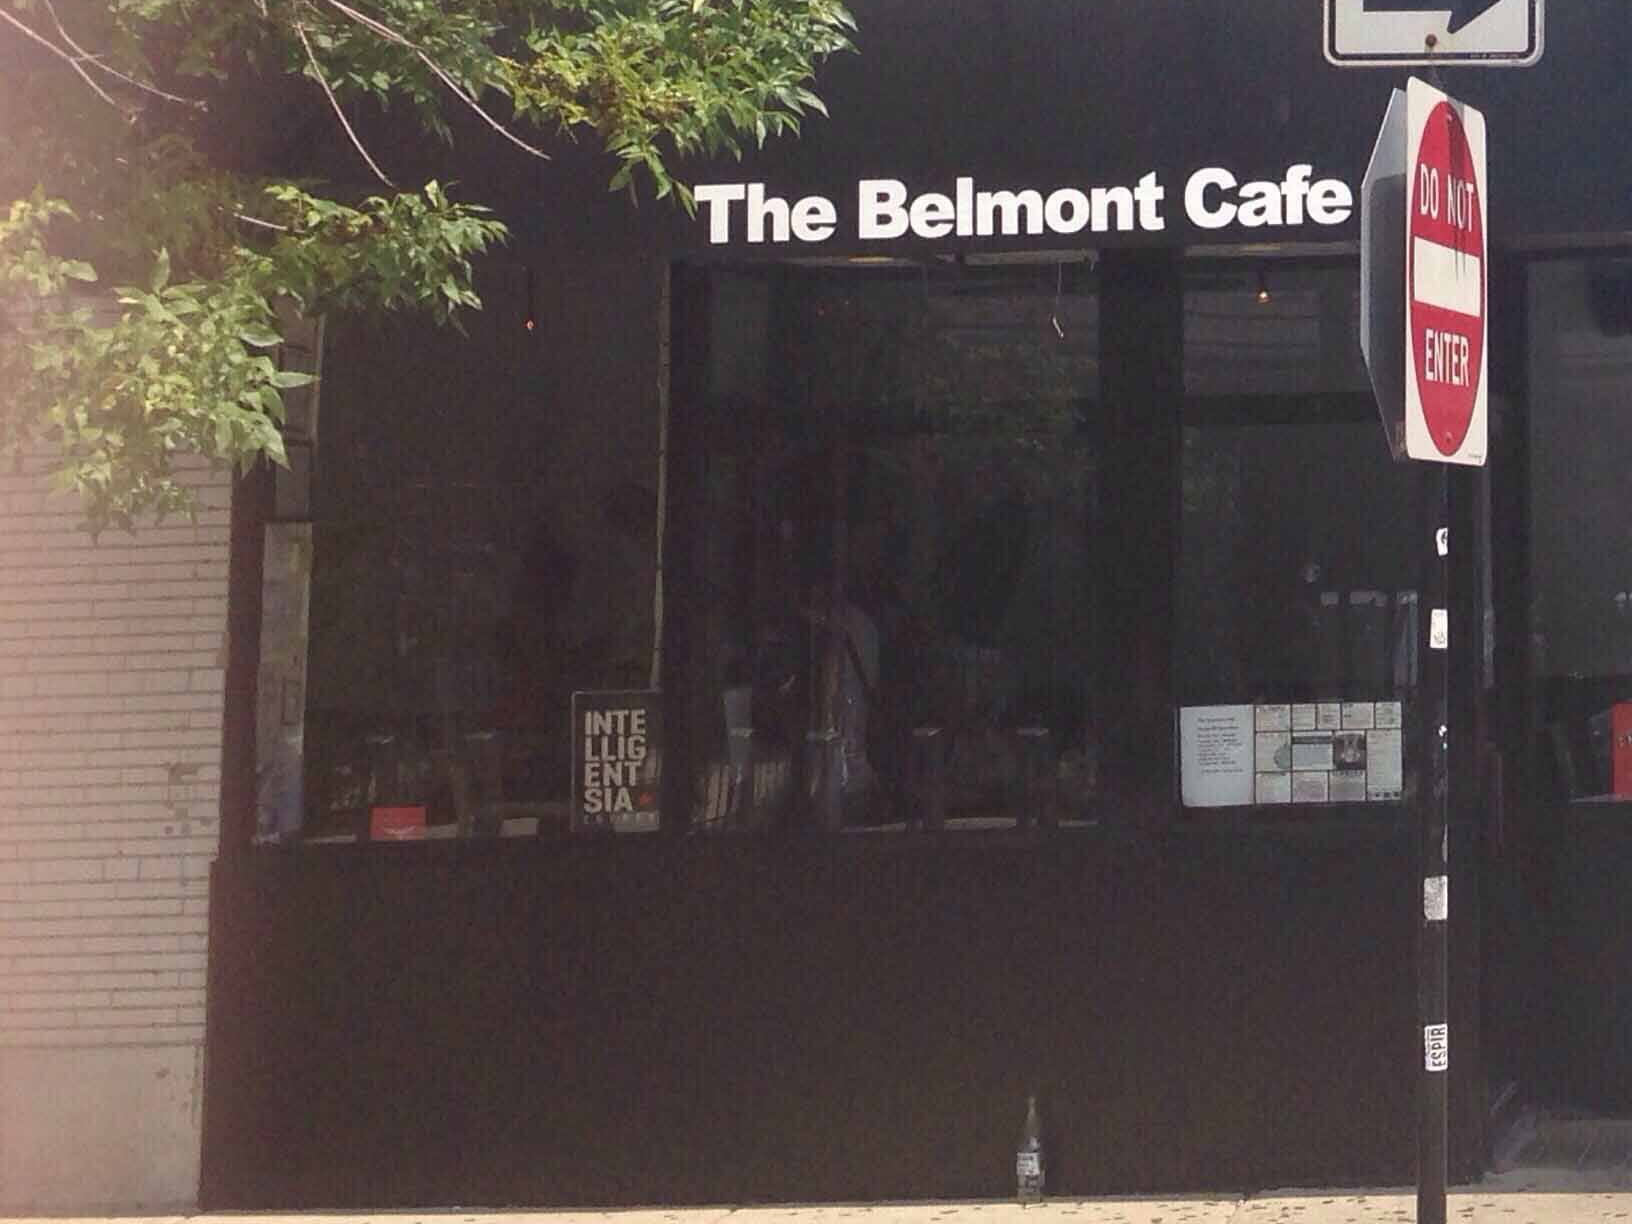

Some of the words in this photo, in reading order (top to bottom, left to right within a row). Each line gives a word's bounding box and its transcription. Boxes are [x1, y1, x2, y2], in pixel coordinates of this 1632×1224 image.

[693, 182, 838, 245] The
[857, 170, 1167, 241] Belmont
[1183, 164, 1353, 229] Cafe
[1419, 163, 1440, 220] DO
[1447, 174, 1475, 233] NOT
[1424, 328, 1471, 387] ENTER
[584, 709, 647, 736] INTE
[584, 734, 647, 762] LLIG
[584, 760, 642, 788] ENT
[583, 787, 634, 813] SIA
